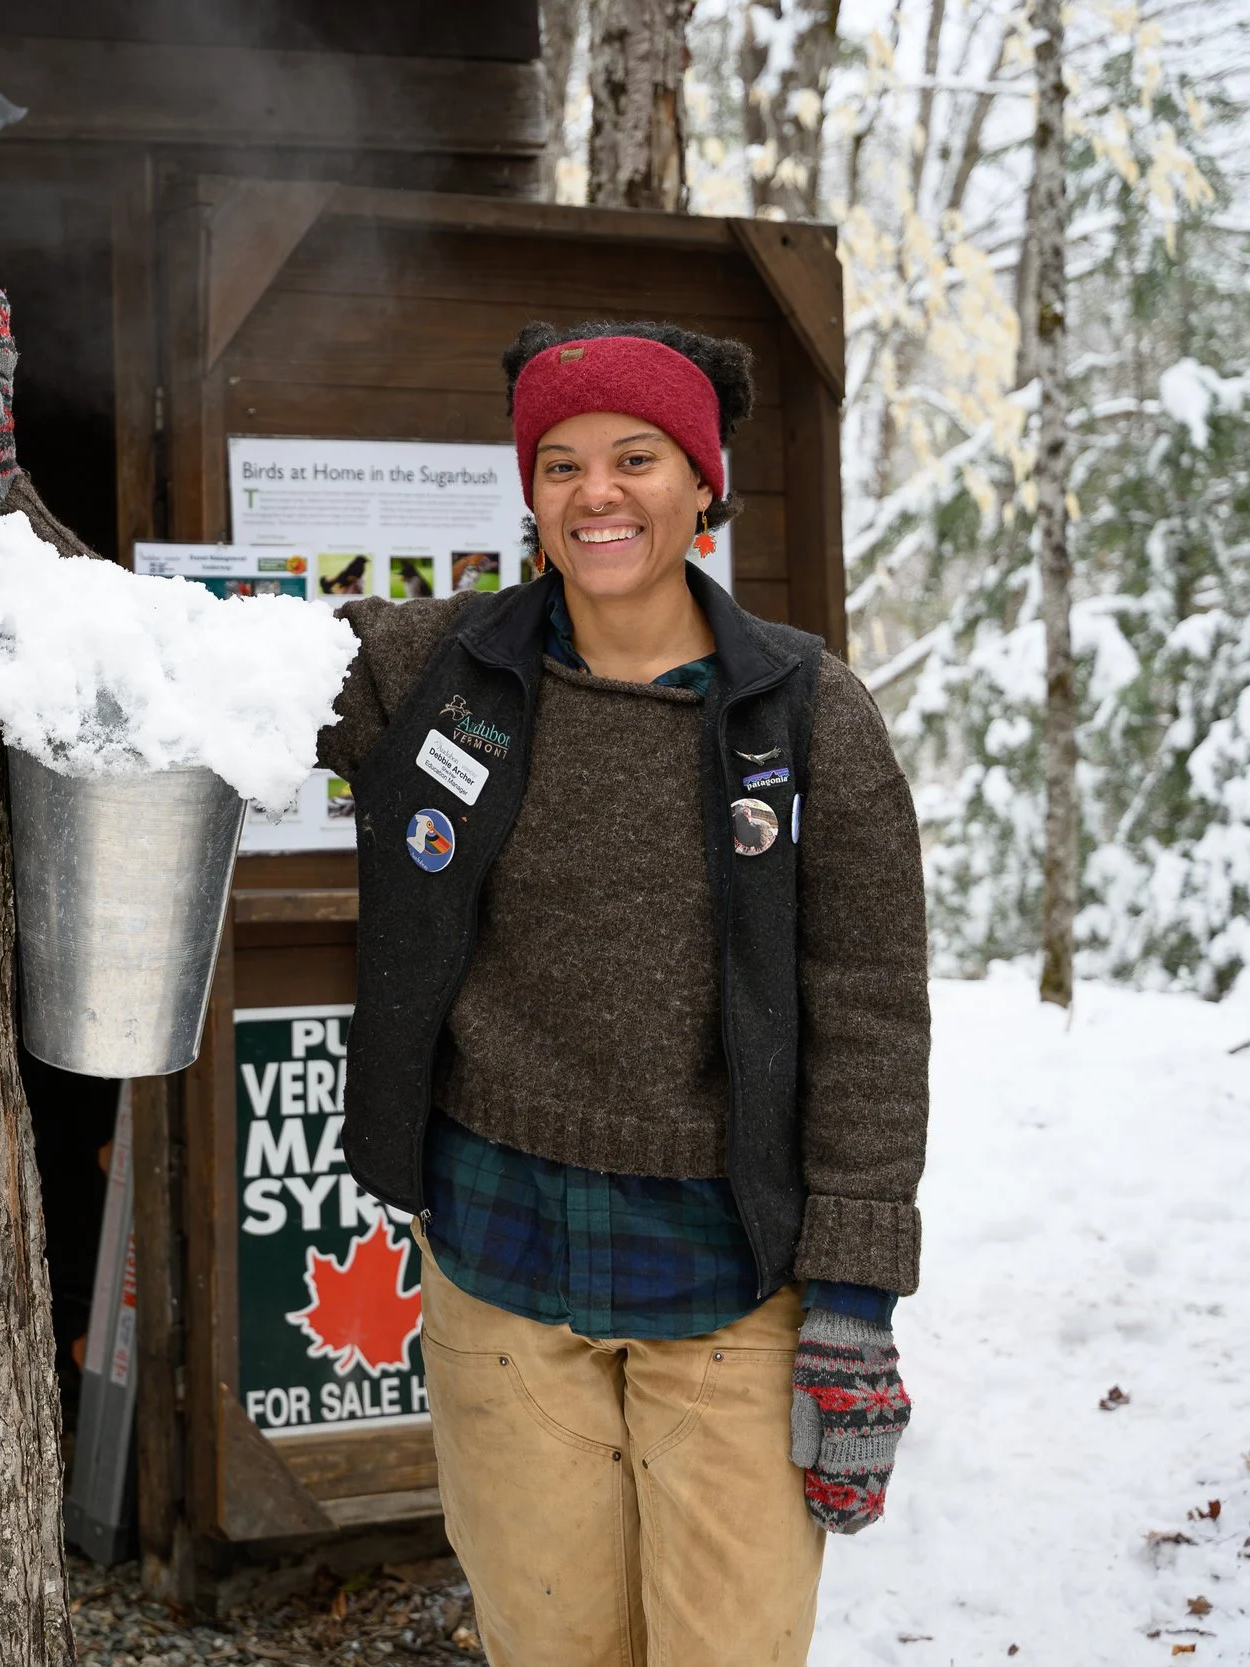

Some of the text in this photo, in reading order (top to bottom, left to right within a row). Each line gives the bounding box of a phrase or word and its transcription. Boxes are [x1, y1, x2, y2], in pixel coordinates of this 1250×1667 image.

[242, 461, 498, 487] Birds at Home in the Sugarbush
[424, 759, 468, 796] Education Manager
[428, 747, 475, 786] Debbie Archer
[746, 776, 788, 791] patagonia
[241, 1060, 347, 1117] VER
[246, 1386, 312, 1427] FOR
[320, 1377, 402, 1422] SALE
